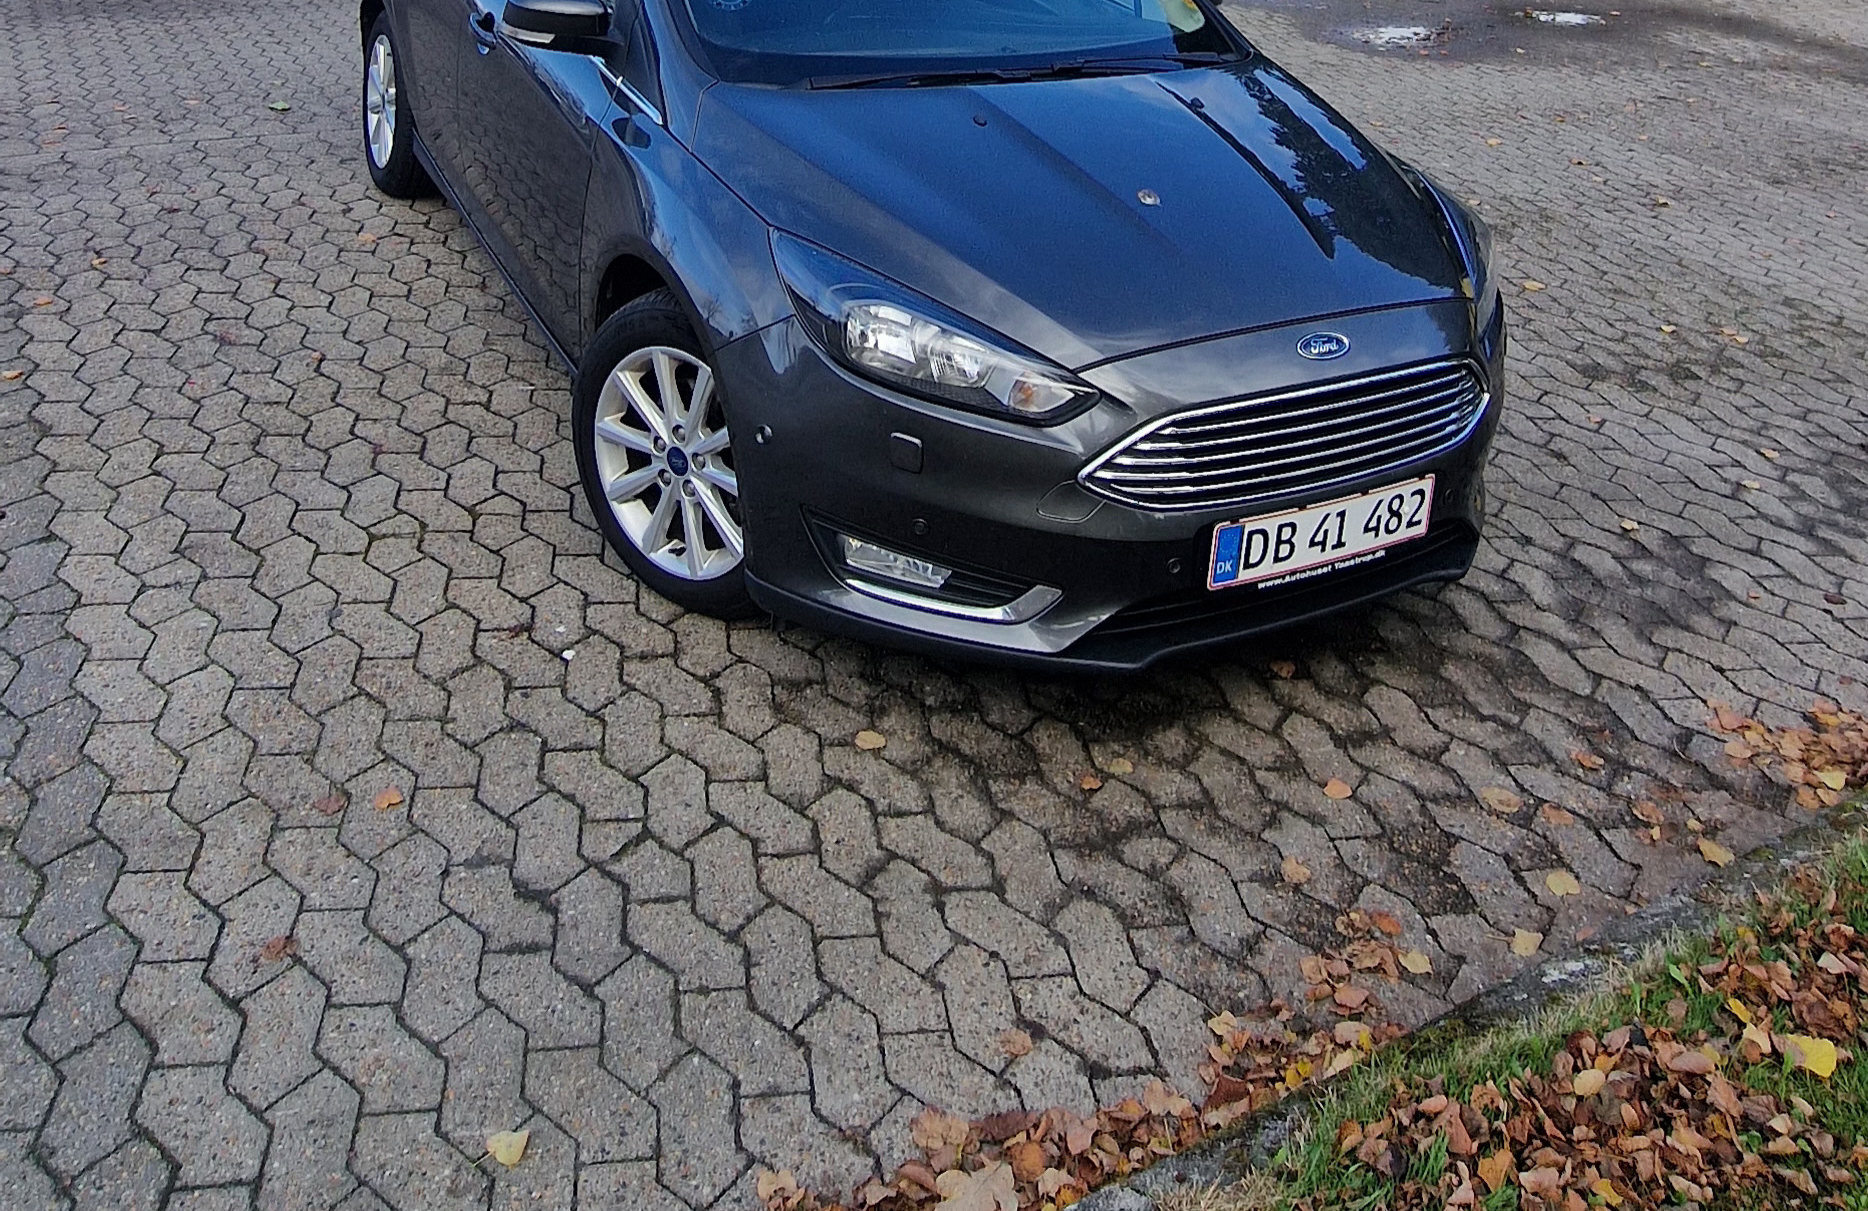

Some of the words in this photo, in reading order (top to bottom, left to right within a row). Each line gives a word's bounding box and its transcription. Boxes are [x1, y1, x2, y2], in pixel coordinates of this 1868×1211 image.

[1310, 337, 1339, 354] Ford
[1242, 521, 1298, 570] DB
[1308, 509, 1348, 553] 41
[1363, 488, 1426, 538] 482
[1216, 559, 1233, 574] DK
